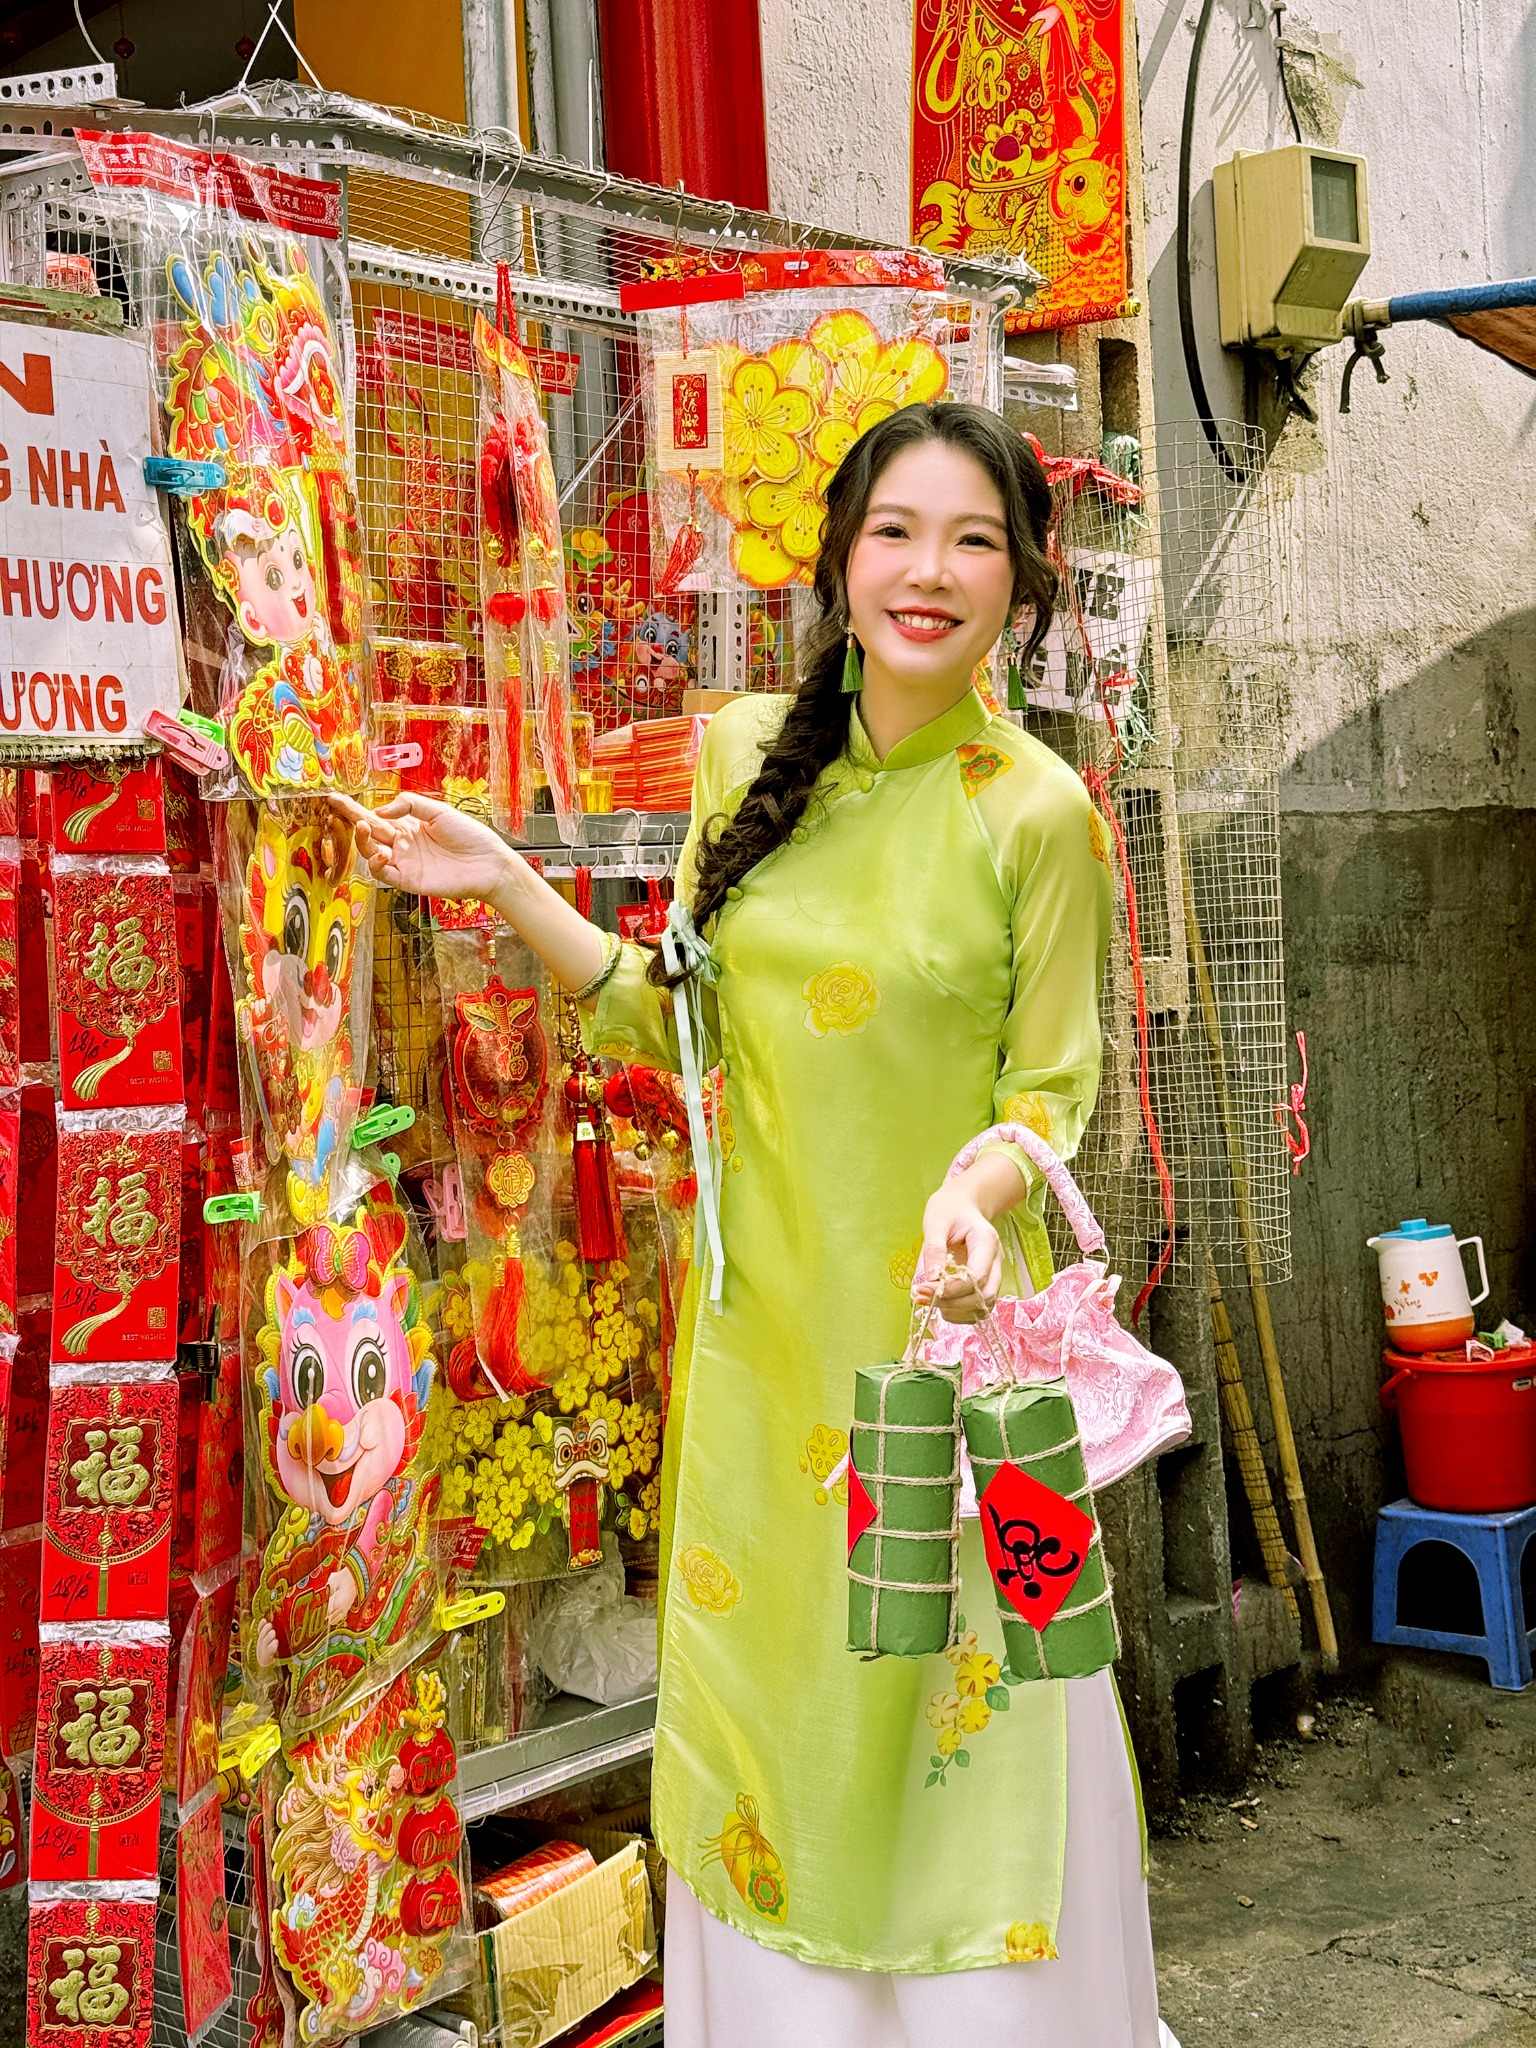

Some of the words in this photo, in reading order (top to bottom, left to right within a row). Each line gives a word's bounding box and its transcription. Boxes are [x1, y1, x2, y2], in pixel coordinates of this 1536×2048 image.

[27, 439, 127, 513] NHÀ
[83, 916, 156, 990] 福
[82, 1171, 158, 1247] 福
[70, 1426, 151, 1505] 福
[59, 1687, 141, 1766] 福
[49, 1944, 130, 2024] 福
